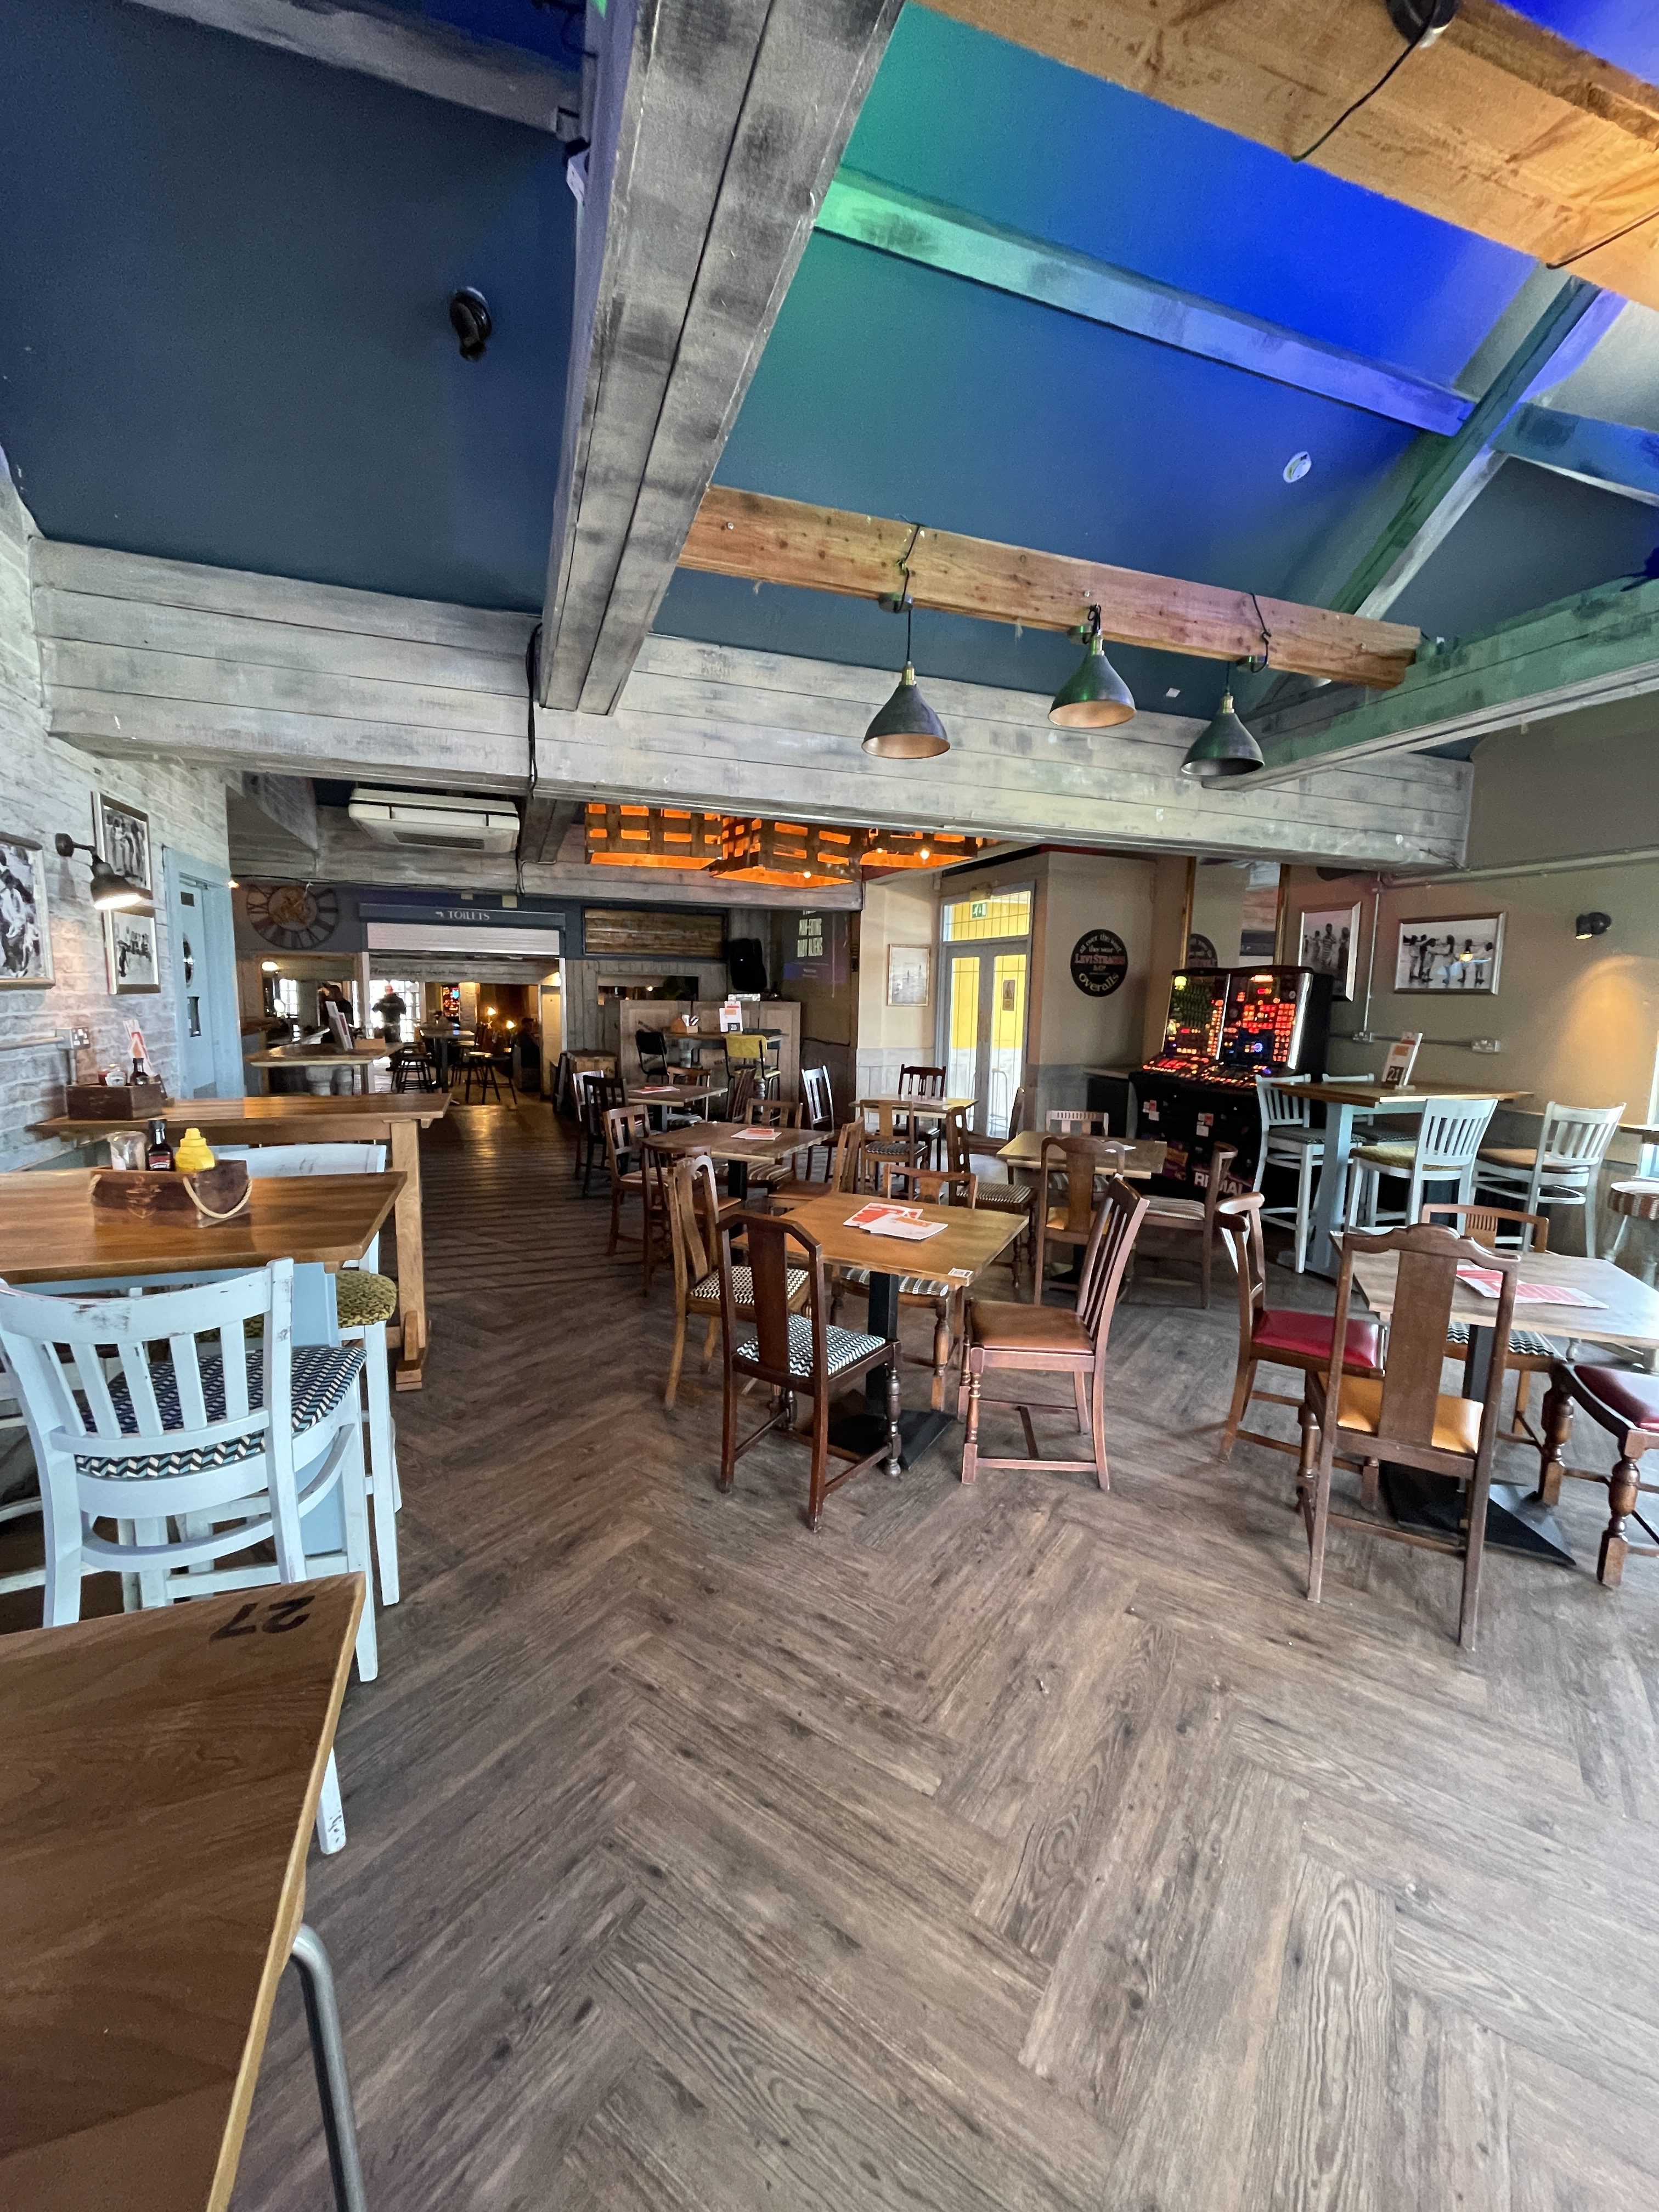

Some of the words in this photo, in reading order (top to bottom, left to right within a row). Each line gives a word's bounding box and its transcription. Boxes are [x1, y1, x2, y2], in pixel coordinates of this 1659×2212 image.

[447, 910, 490, 921] TOILETS
[1099, 933, 1110, 941] the
[1079, 973, 1119, 992] Overalls
[1387, 1067, 1401, 1081] 21
[209, 1595, 316, 1641] 27
